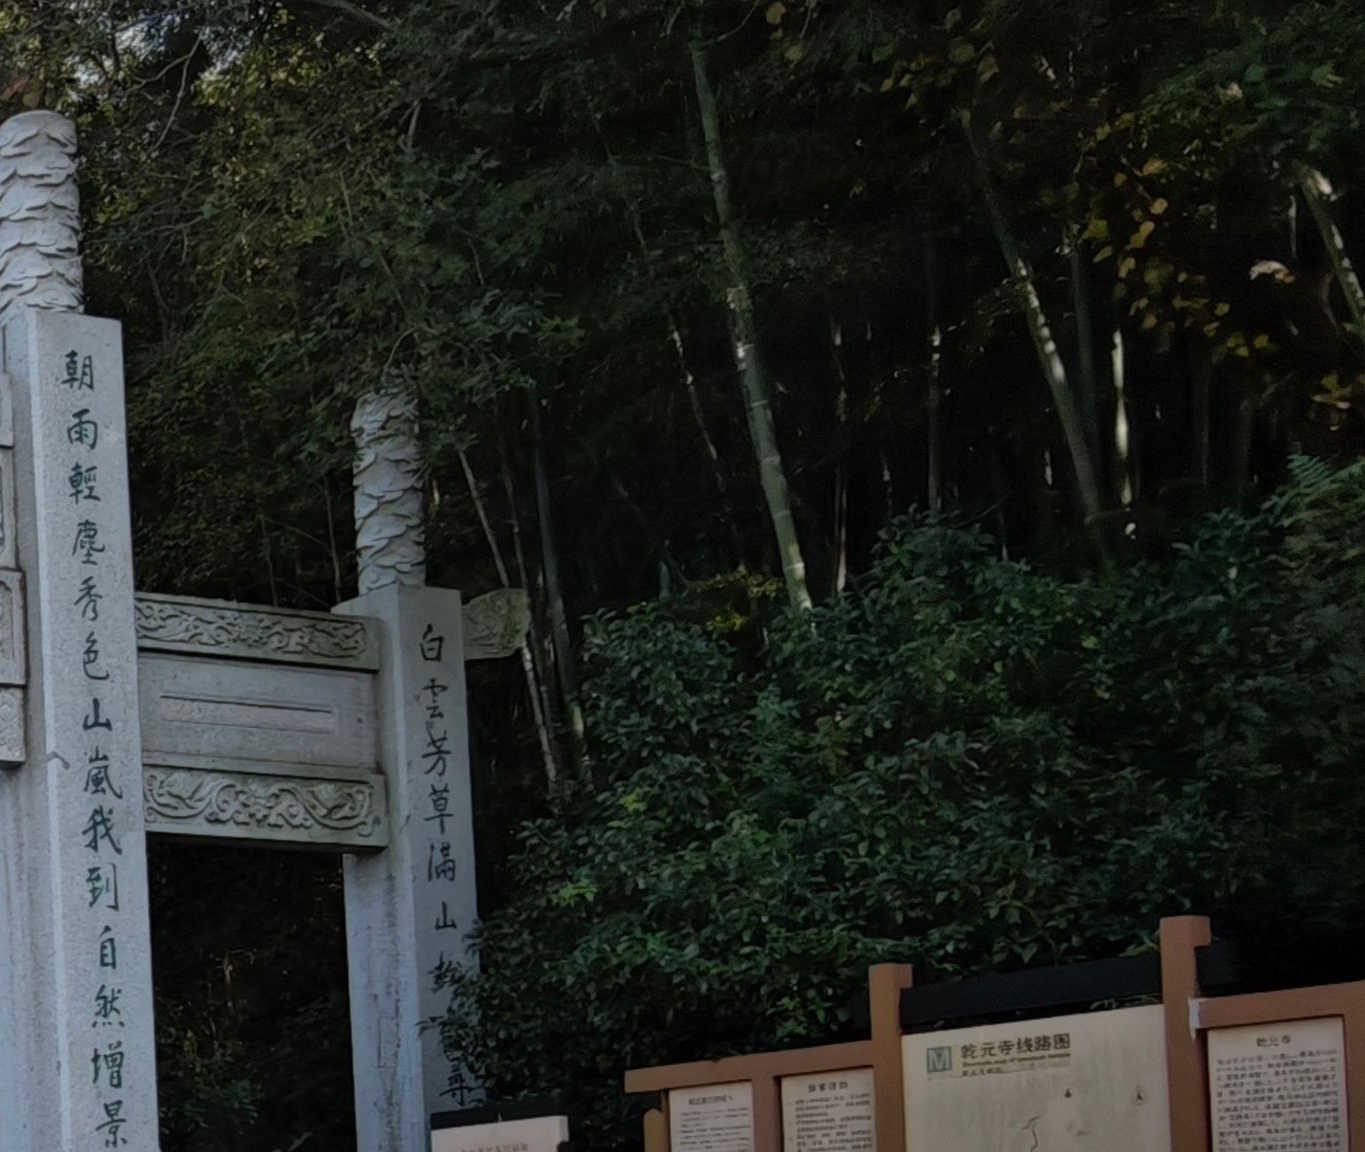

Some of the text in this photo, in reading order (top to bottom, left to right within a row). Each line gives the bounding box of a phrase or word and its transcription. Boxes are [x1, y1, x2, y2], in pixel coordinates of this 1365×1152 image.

[960, 1033, 1071, 1060] 乾元寺线路图
